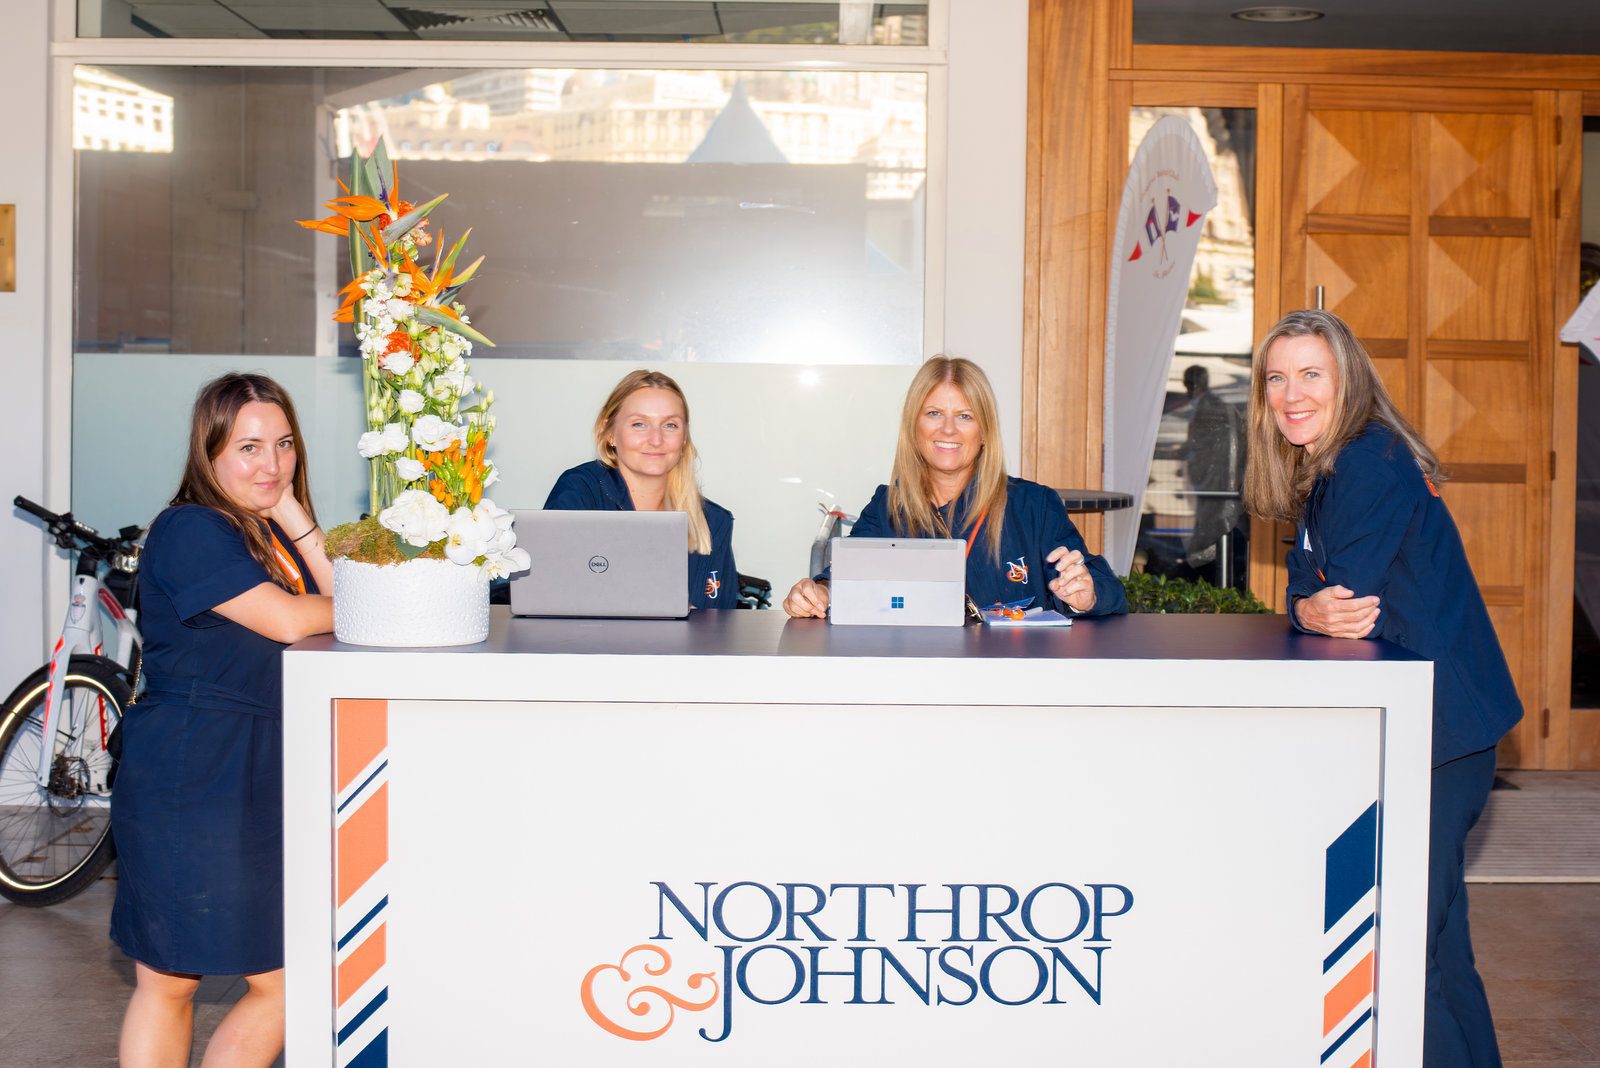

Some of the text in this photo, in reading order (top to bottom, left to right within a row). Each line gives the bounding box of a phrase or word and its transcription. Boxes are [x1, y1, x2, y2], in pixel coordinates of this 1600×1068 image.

[649, 882, 1135, 945] NORTHROP
[580, 943, 1112, 1044] & JOHNSON
